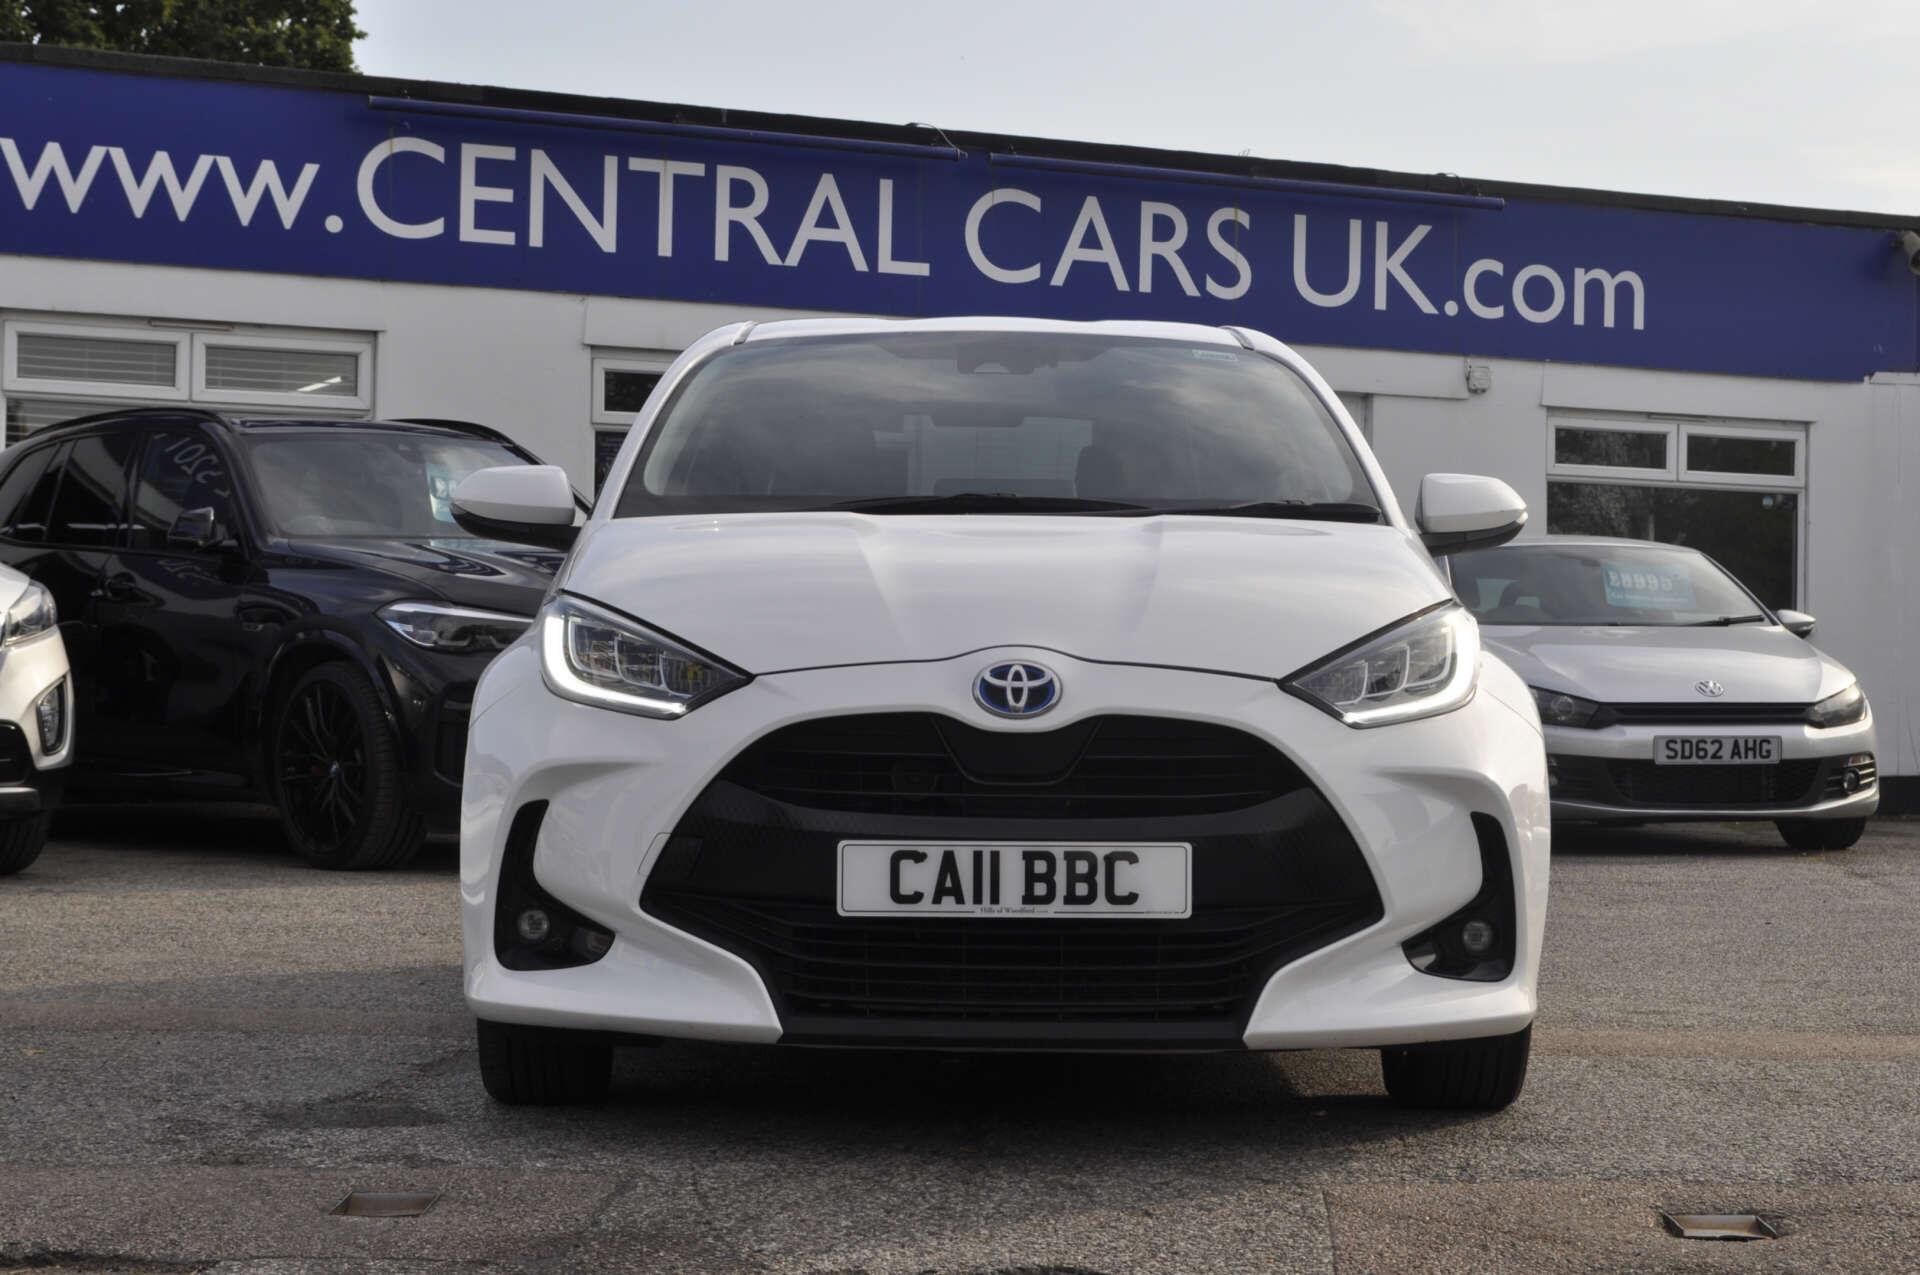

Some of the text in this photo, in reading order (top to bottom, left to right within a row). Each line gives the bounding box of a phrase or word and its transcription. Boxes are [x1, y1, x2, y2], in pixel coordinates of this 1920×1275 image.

[964, 188, 1253, 299] CARS
[1293, 214, 1645, 330] UK.com
[1665, 739, 1772, 760] SD62 AHG
[889, 850, 1140, 905] CA11 BBC
